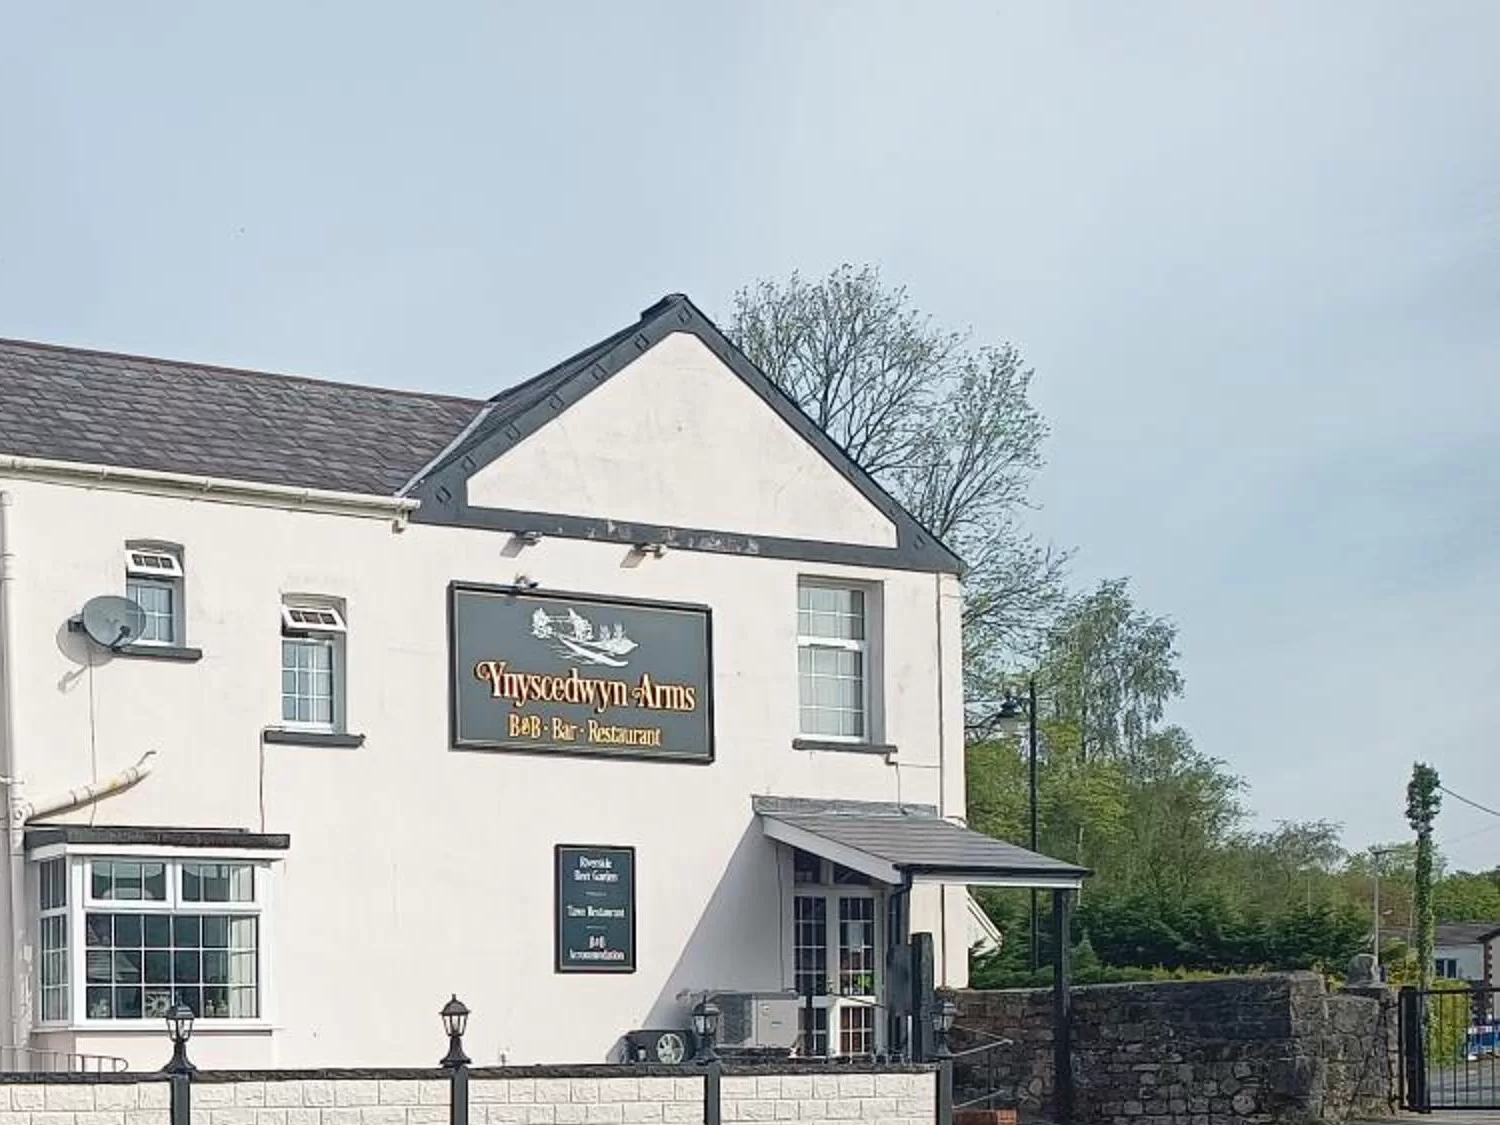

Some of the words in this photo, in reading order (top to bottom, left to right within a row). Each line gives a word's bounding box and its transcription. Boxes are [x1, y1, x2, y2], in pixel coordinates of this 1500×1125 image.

[476, 661, 628, 713] Ynyscedwyn
[631, 672, 696, 711] Arms
[552, 717, 577, 741] Bar
[587, 719, 661, 747] Restaurant
